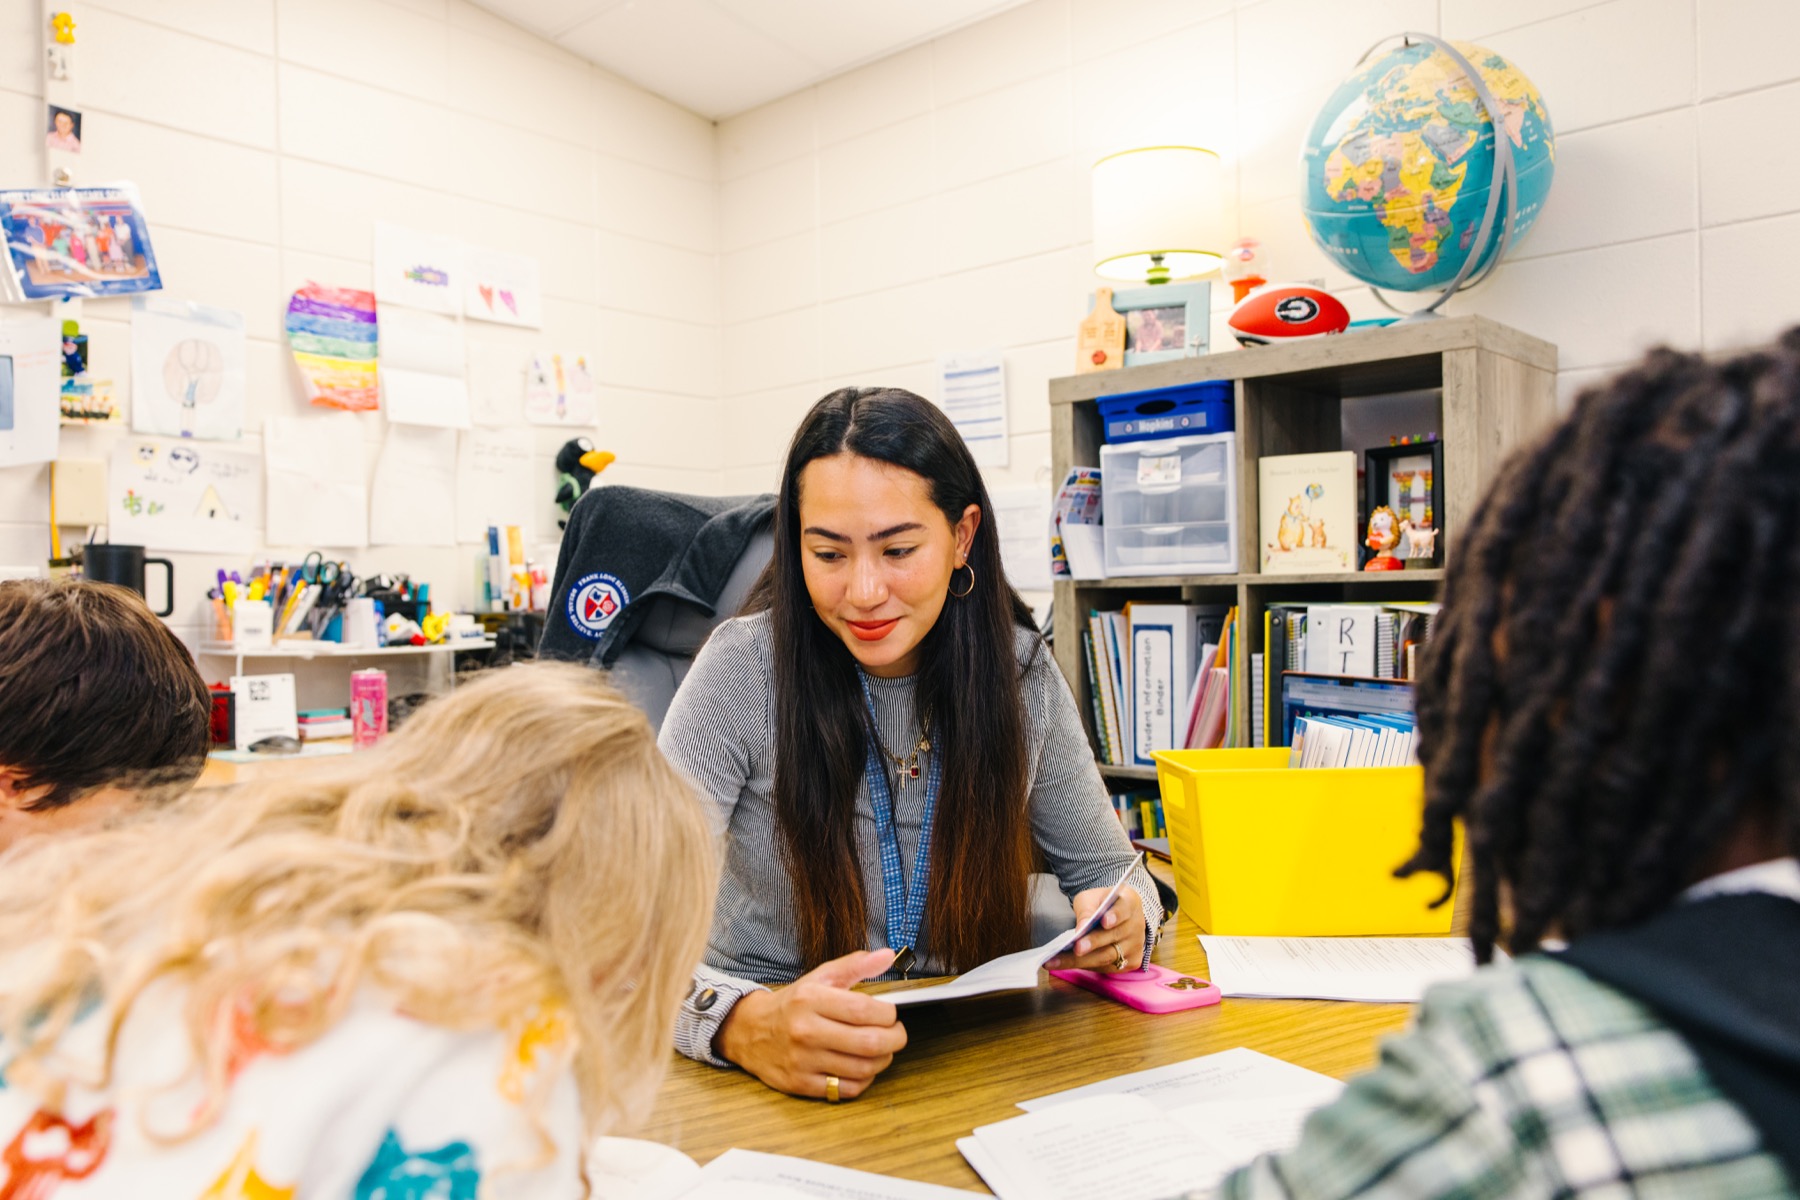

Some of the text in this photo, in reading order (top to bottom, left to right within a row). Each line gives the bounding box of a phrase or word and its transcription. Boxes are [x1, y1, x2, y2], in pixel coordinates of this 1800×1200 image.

[1276, 296, 1319, 323] G
[1138, 418, 1174, 434] Hopkins
[599, 573, 617, 583] LONG
[1143, 637, 1153, 755] Student Information
[1156, 680, 1164, 716] Binder
